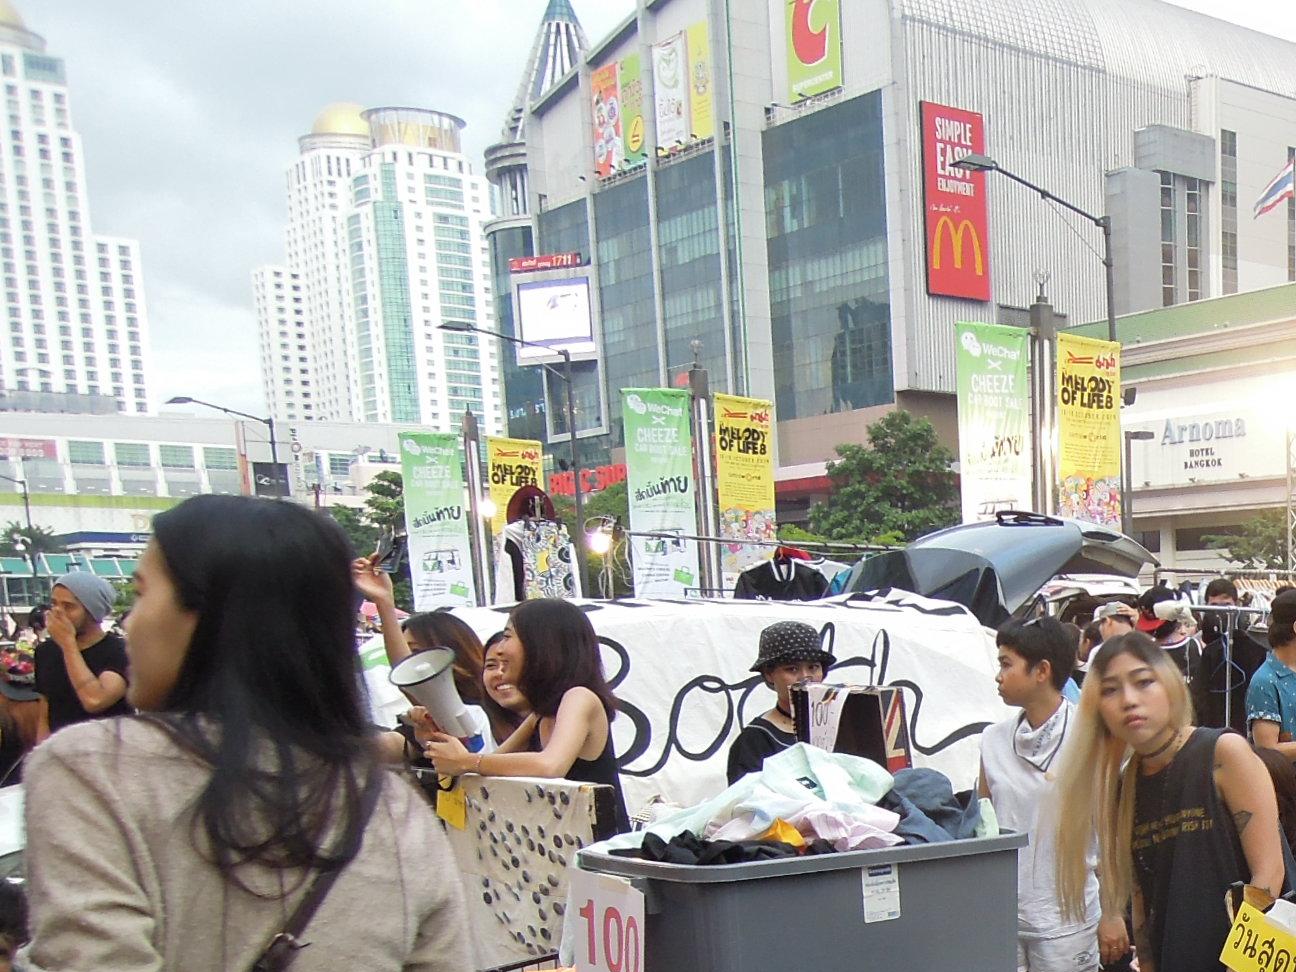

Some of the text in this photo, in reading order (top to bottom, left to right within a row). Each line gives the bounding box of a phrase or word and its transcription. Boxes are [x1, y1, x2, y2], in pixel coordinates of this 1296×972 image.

[935, 116, 973, 146] SIMPLE
[937, 178, 975, 197] ENJOYMENT
[982, 342, 1021, 361] WeChat
[970, 374, 1015, 393] CHEEZE
[1061, 371, 1114, 393] MELODY
[1061, 387, 1077, 406] OF
[1081, 392, 1104, 409] LIFE
[647, 402, 683, 417] WeChat
[636, 427, 679, 442] CHEEZE
[719, 425, 768, 443] MELODY
[1161, 418, 1246, 445] Arnoma
[719, 437, 734, 452] OF
[738, 440, 759, 455] LIFE
[1189, 447, 1215, 458] HOTEL
[492, 462, 537, 477] MELODY
[1184, 458, 1222, 470] BANGKOK
[491, 474, 506, 485] OF
[511, 476, 530, 487] LIFE
[549, 470, 576, 496] BIG
[579, 468, 595, 493] C
